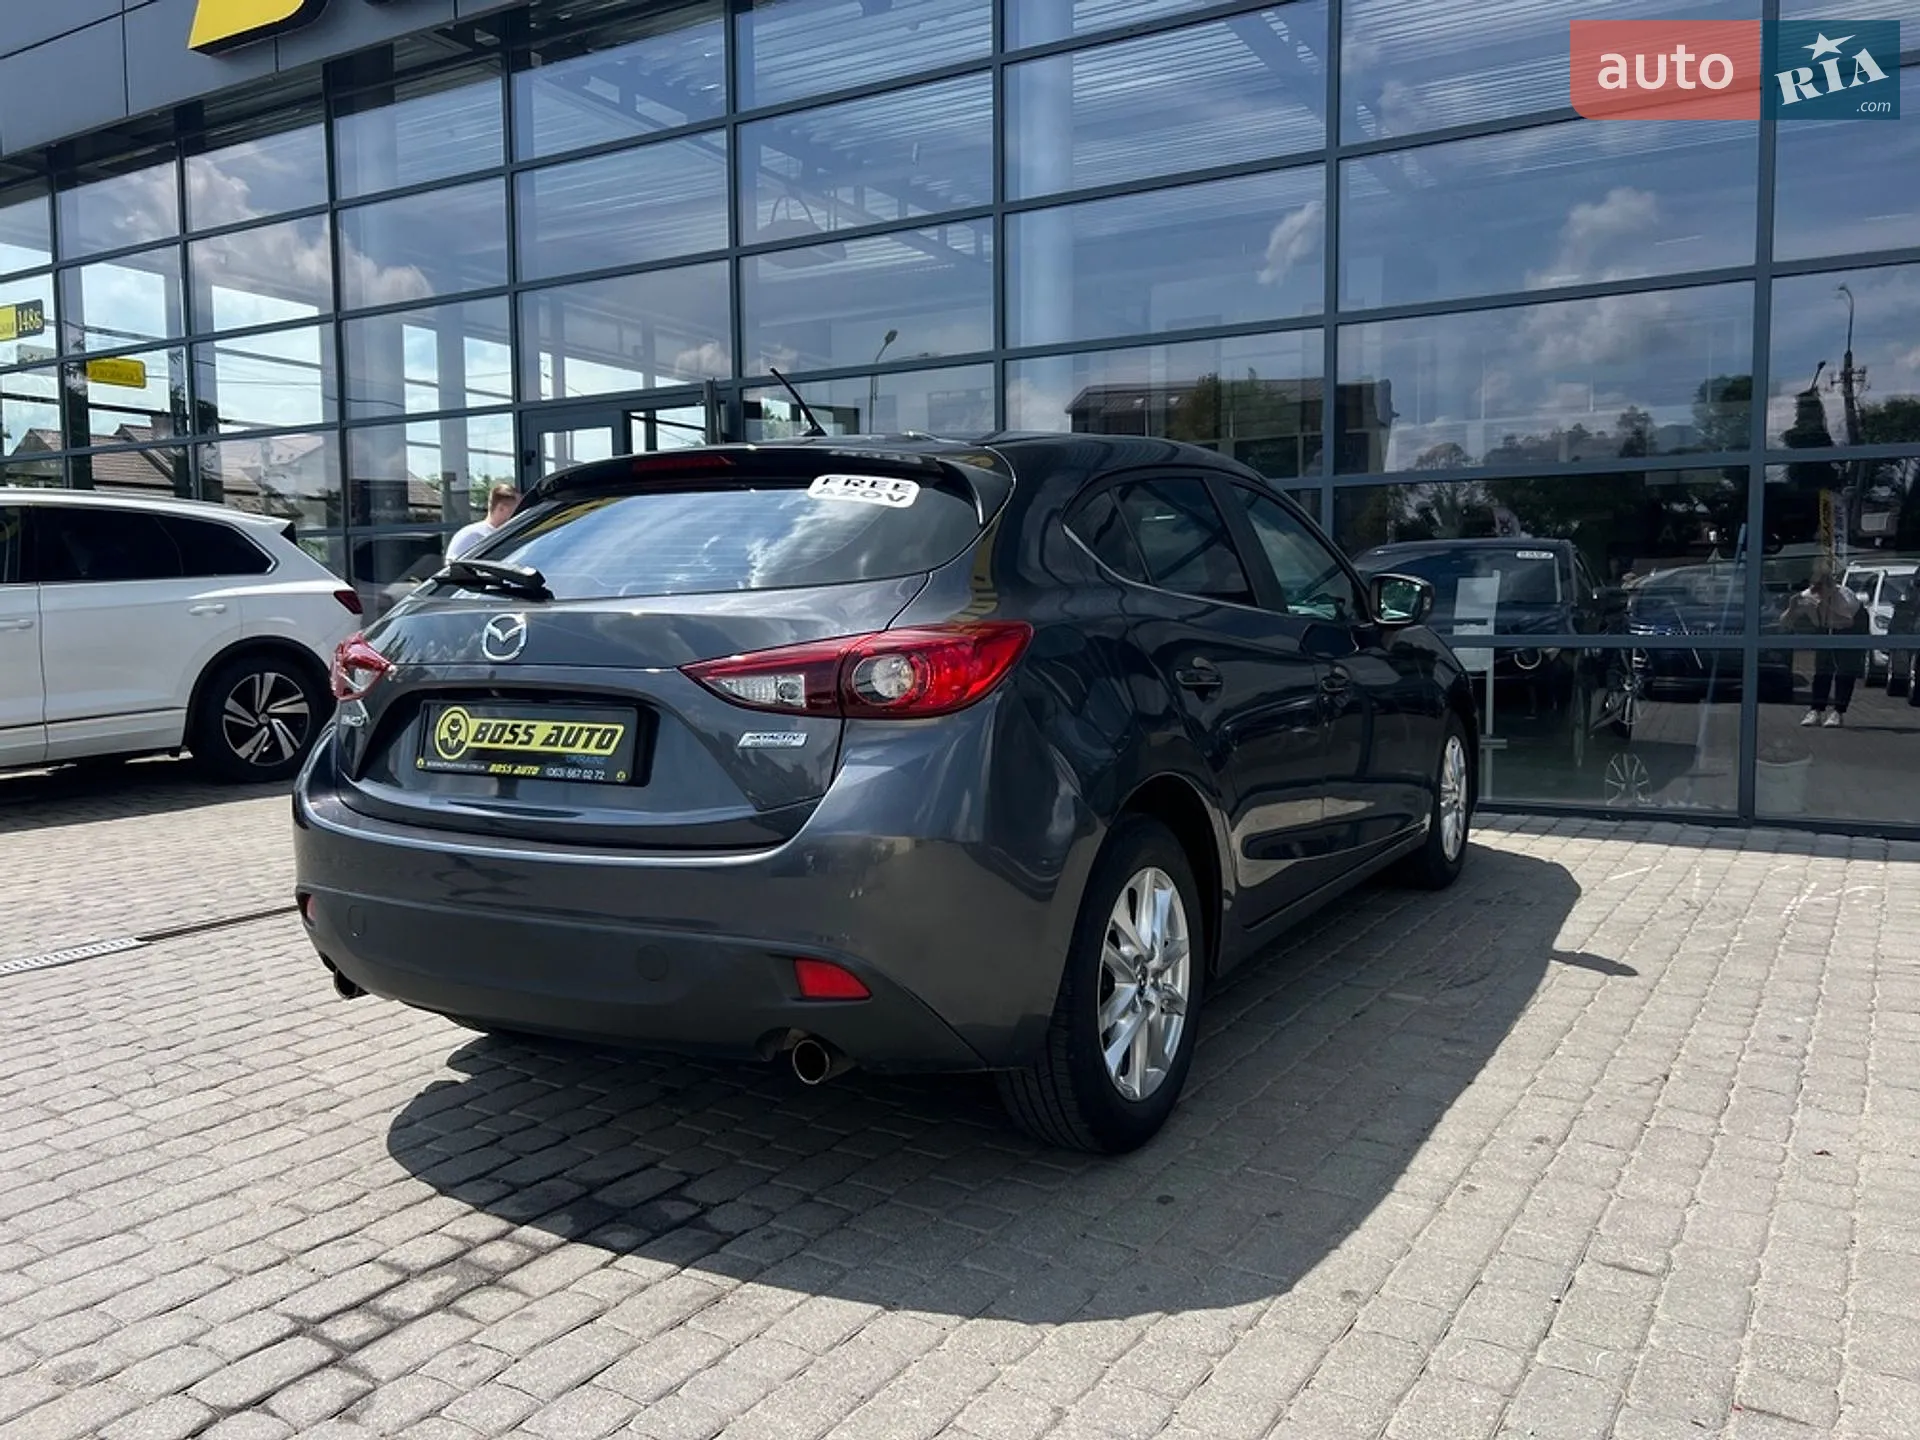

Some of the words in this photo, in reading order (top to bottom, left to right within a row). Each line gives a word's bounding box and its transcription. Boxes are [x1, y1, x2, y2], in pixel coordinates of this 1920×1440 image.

[823, 477, 913, 494] FREE
[815, 487, 907, 502] AZOV
[471, 722, 536, 745] BOSS
[540, 725, 618, 750] AUTO
[488, 763, 513, 774] BOSS
[514, 765, 541, 776] AUTO
